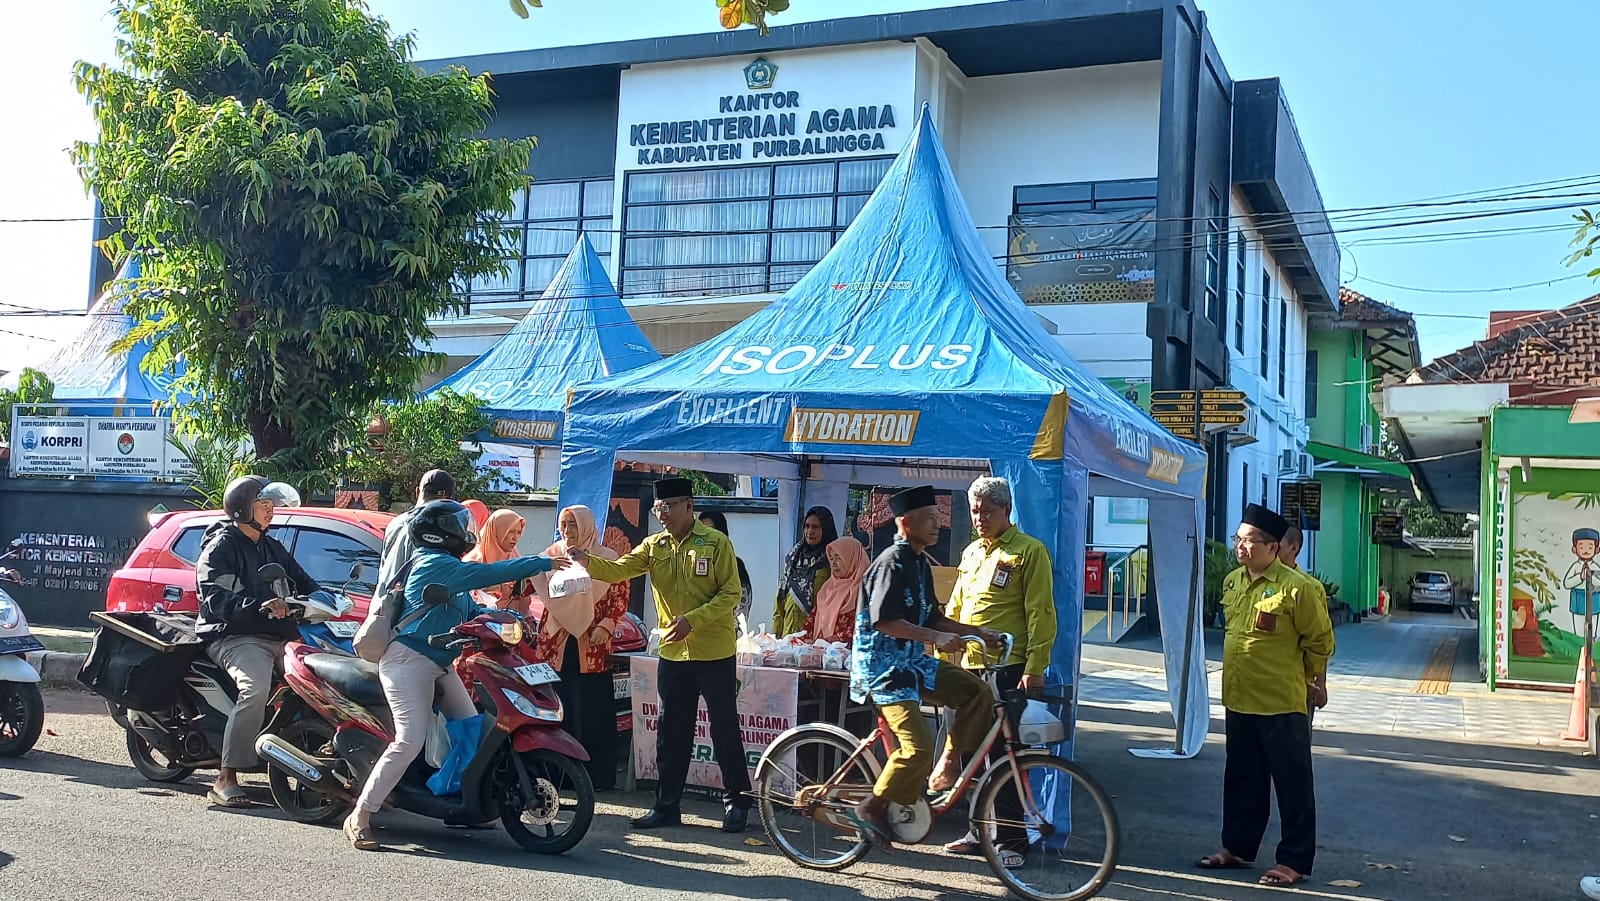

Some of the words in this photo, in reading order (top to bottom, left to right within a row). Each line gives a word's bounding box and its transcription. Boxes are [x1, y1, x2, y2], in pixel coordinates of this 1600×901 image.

[719, 91, 799, 113] KANTOR
[630, 113, 796, 146] KEMENTERIAN
[806, 104, 896, 134] AGAMA
[637, 143, 742, 165] KABUPATEN
[752, 132, 885, 158] PURBALINGGA
[702, 344, 973, 375] ISOPLUS
[677, 397, 786, 425] EXCELLENT
[793, 411, 914, 442] HYDRATION
[495, 421, 556, 439] HYDRATION
[41, 436, 83, 447] KORPRI
[20, 532, 105, 548] KEMENTERIAN
[44, 549, 124, 564] KEMENTERIAN
[44, 565, 82, 577] Mayjend
[748, 713, 789, 730] AGAMA
